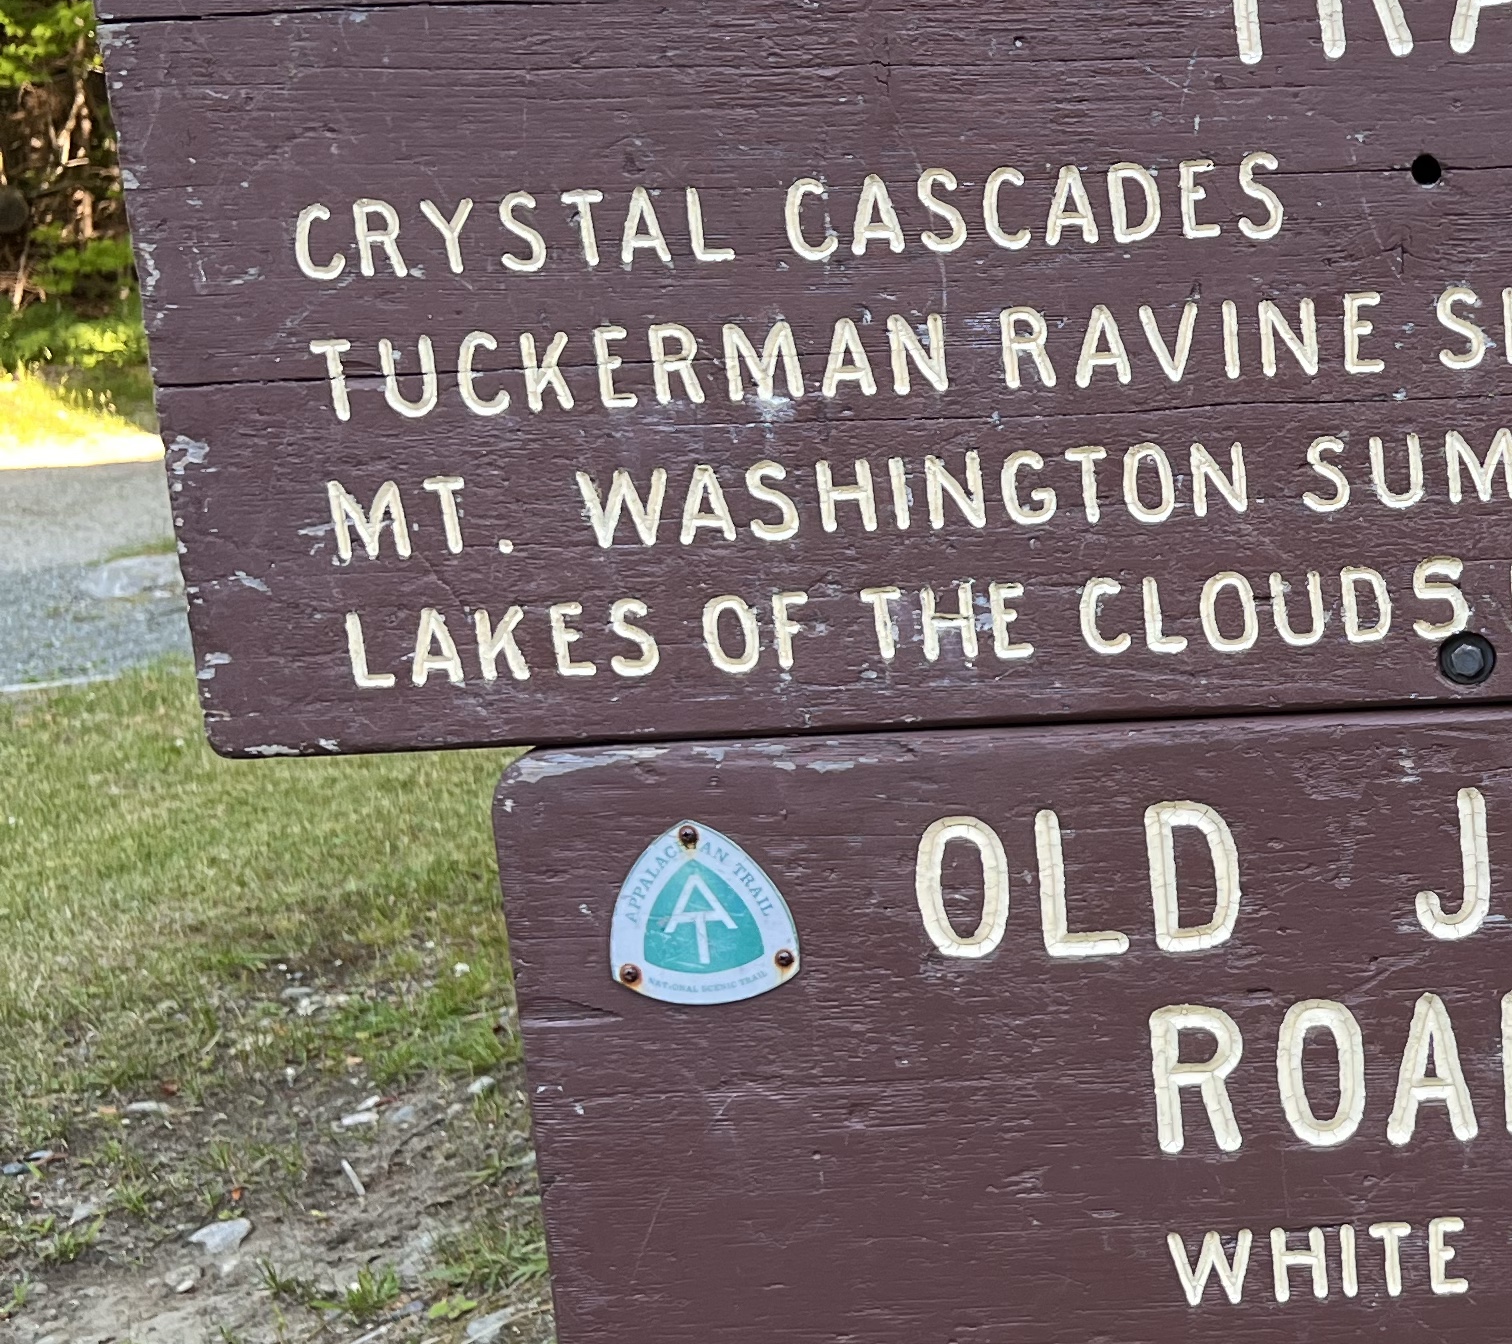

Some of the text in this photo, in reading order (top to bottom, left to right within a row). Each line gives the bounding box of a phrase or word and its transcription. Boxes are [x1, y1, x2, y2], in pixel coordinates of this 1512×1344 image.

[293, 185, 737, 282] CRYSTAL
[783, 152, 1286, 262] CASCADES
[307, 312, 950, 424] TUCKERMAN
[998, 290, 1387, 391] RAVINE
[325, 475, 514, 566] MT.
[574, 440, 1250, 550] WASHINGTON
[343, 596, 661, 690] LAKES
[700, 590, 810, 675] OF
[858, 576, 1036, 666] THE
[1077, 556, 1475, 657] CLOUDS
[625, 840, 774, 923] APPALACAN TRAIL
[913, 798, 1243, 962] OLD
[1165, 1216, 1470, 1308] WHITE
